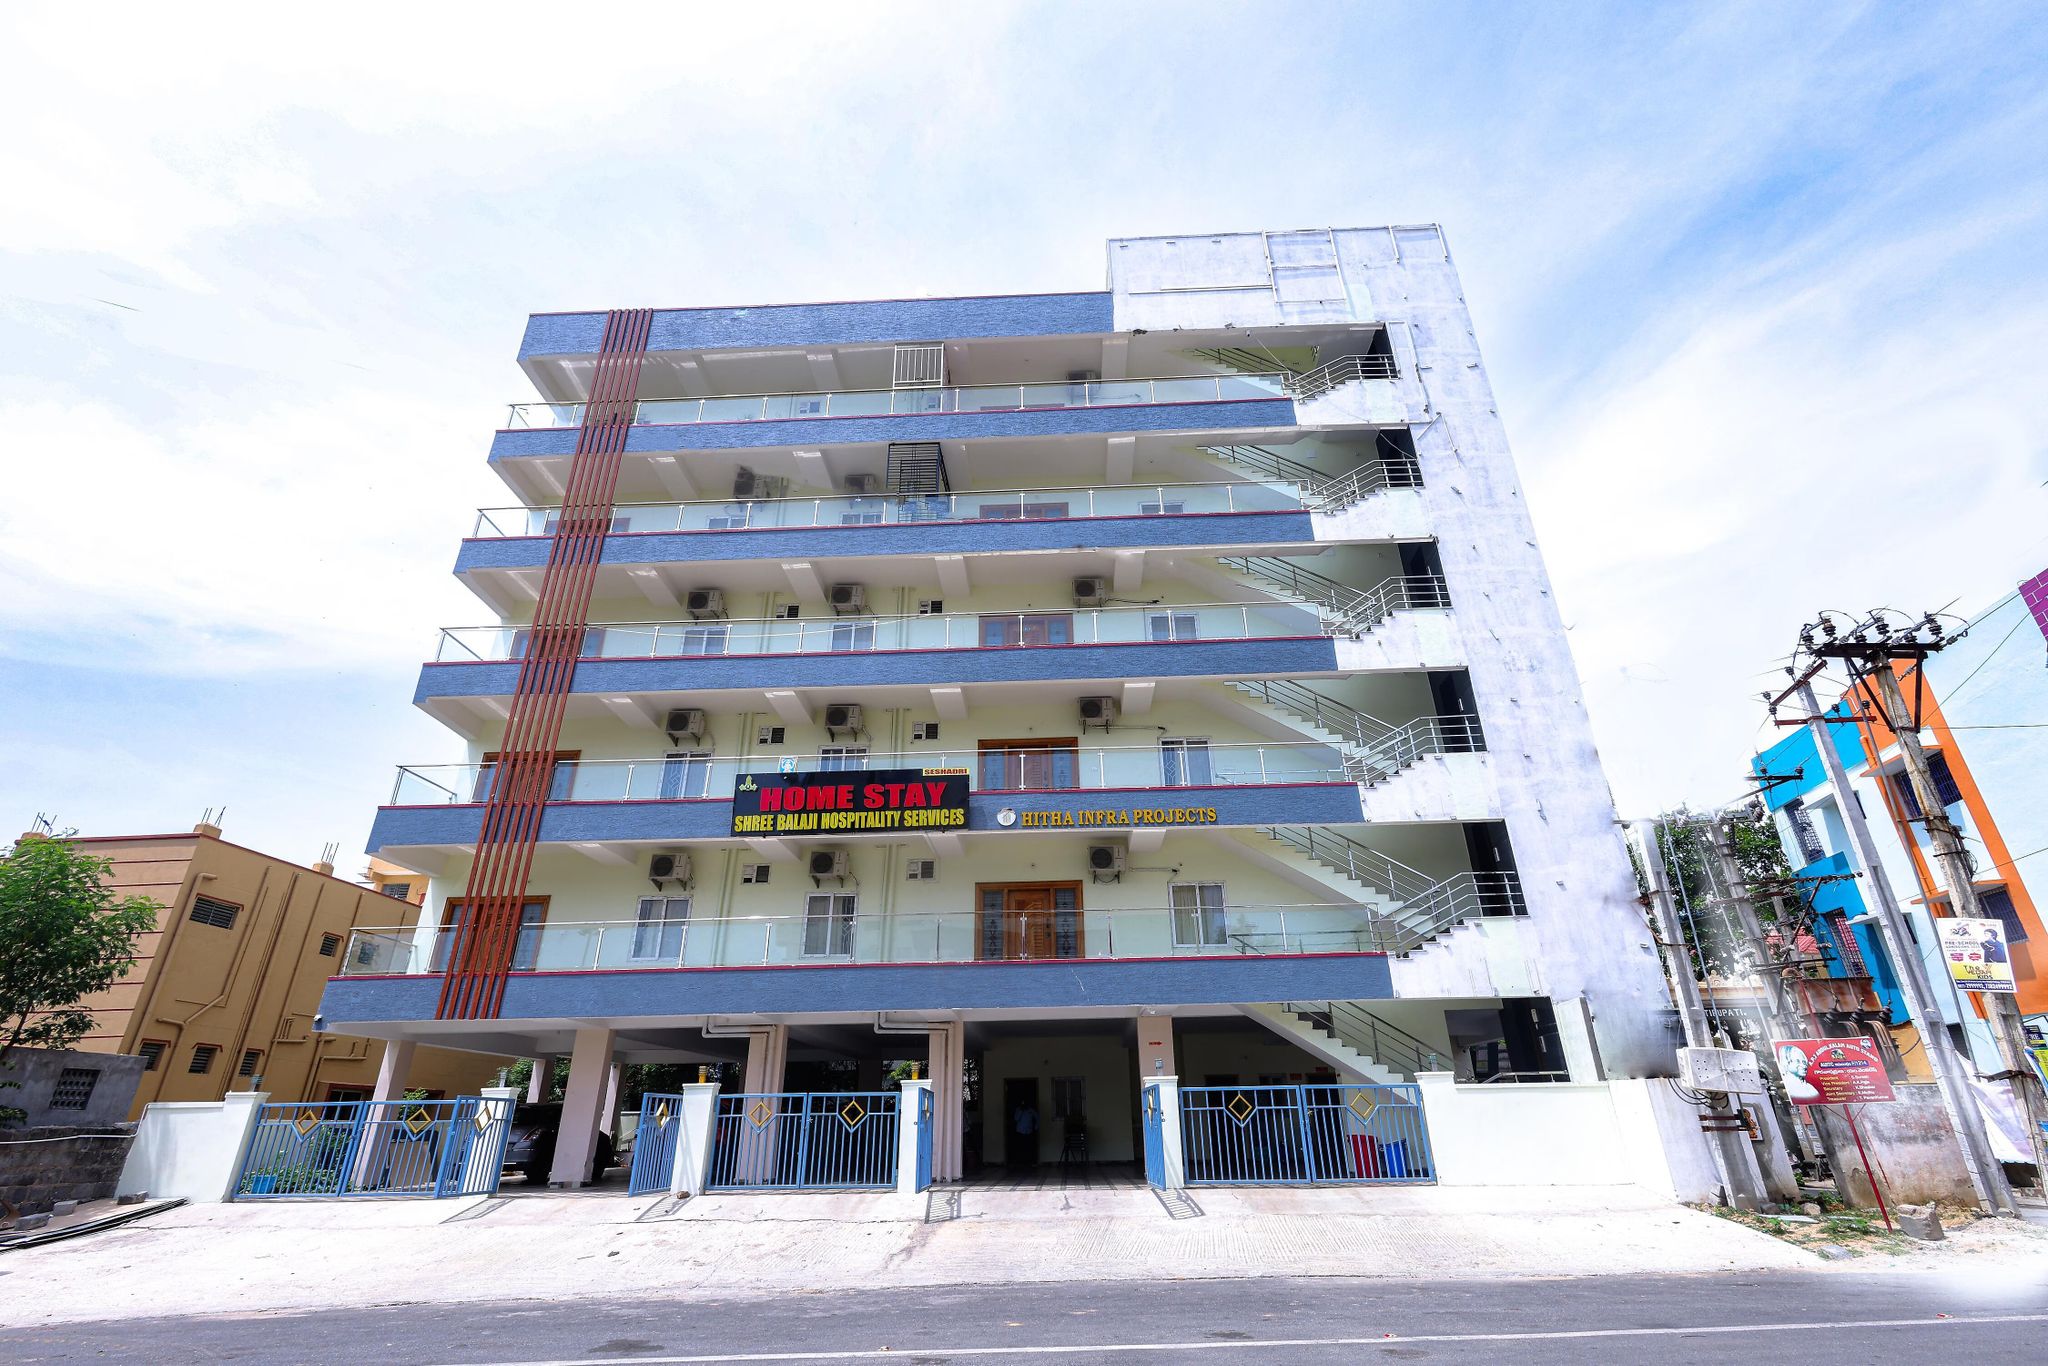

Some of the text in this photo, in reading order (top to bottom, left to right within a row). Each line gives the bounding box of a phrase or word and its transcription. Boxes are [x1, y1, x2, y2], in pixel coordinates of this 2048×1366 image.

[760, 782, 949, 812] HOME STAY
[734, 808, 965, 833] SHREE BALAJI HOSPITALITY SERVICES
[1021, 808, 1217, 826] HITHA INFRA PROJECTS
